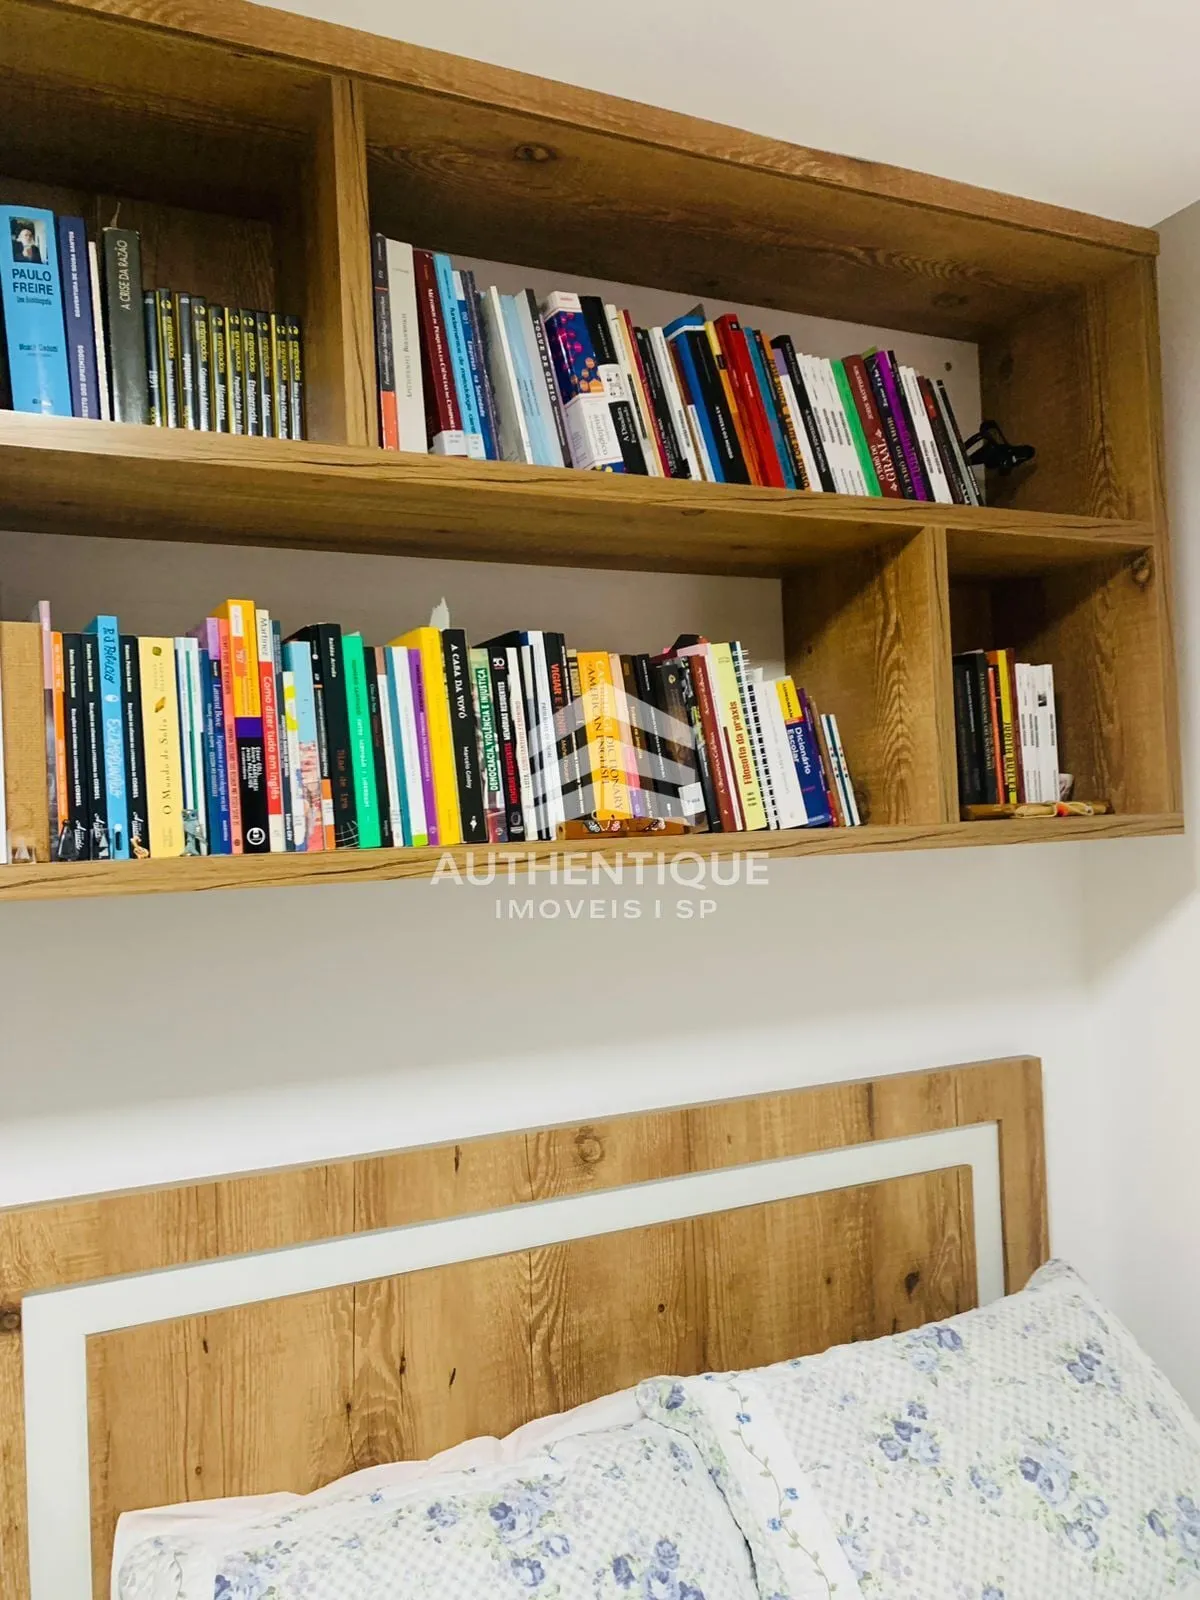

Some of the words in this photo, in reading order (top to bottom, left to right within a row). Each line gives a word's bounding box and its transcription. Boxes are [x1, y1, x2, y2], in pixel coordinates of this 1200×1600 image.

[67, 230, 76, 252] SANTOS
[113, 239, 128, 267] RAZÃO
[12, 268, 52, 282] PAULO
[117, 267, 129, 280] DA
[13, 282, 54, 296] FREIRE
[118, 280, 130, 302] CRISE
[532, 318, 546, 351] TOQUE
[540, 354, 549, 367] DE
[181, 352, 193, 391] Juventude
[849, 364, 870, 401] MATTHEWS
[214, 383, 227, 420] Migrantes
[262, 392, 271, 416] Idosos
[474, 384, 486, 417] Sociedade
[862, 401, 875, 420] JOHN
[884, 415, 900, 442] AMOR
[723, 438, 734, 459] MUNDO
[869, 443, 878, 456] DO
[875, 437, 897, 482] GRAAL
[894, 444, 904, 458] DO
[259, 617, 269, 656] Martinez
[450, 643, 458, 651] A
[329, 657, 337, 678] Arruda
[451, 652, 461, 677] CASA
[262, 675, 273, 703] Como
[454, 679, 463, 692] DA
[476, 668, 489, 703] INJUSTIÇA
[549, 663, 562, 695] VIGIAR
[212, 683, 222, 710] Laurent
[456, 694, 467, 719] VOVÓ
[214, 709, 223, 728] Bove
[264, 704, 275, 728] dizer
[480, 709, 493, 745] VIOLÊNCIA
[500, 711, 511, 740] MEMÓRIAS
[553, 704, 567, 736] PUNIR
[586, 665, 603, 732] AMERICAN
[595, 733, 611, 785] ENGLISH
[727, 699, 743, 732] práxis
[265, 729, 276, 753] tudo
[734, 732, 745, 745] da
[785, 727, 801, 763] Escolar
[794, 725, 812, 775] Dicionário
[1002, 721, 1015, 754] JUDITH
[159, 749, 168, 759] de
[267, 754, 276, 770] em
[461, 745, 471, 770] Marcelo
[737, 745, 753, 785] Filosofia
[160, 762, 172, 799] Mundo
[255, 762, 263, 776] COLL
[463, 769, 473, 789] Godoy
[605, 734, 623, 811] DICTIONARY
[1004, 756, 1017, 793] BUTLER
[74, 784, 82, 806] CORDEL
[92, 777, 100, 800] CORDEL
[130, 777, 138, 798] CORDEL
[266, 771, 280, 800] inglês
[162, 804, 172, 814] O
